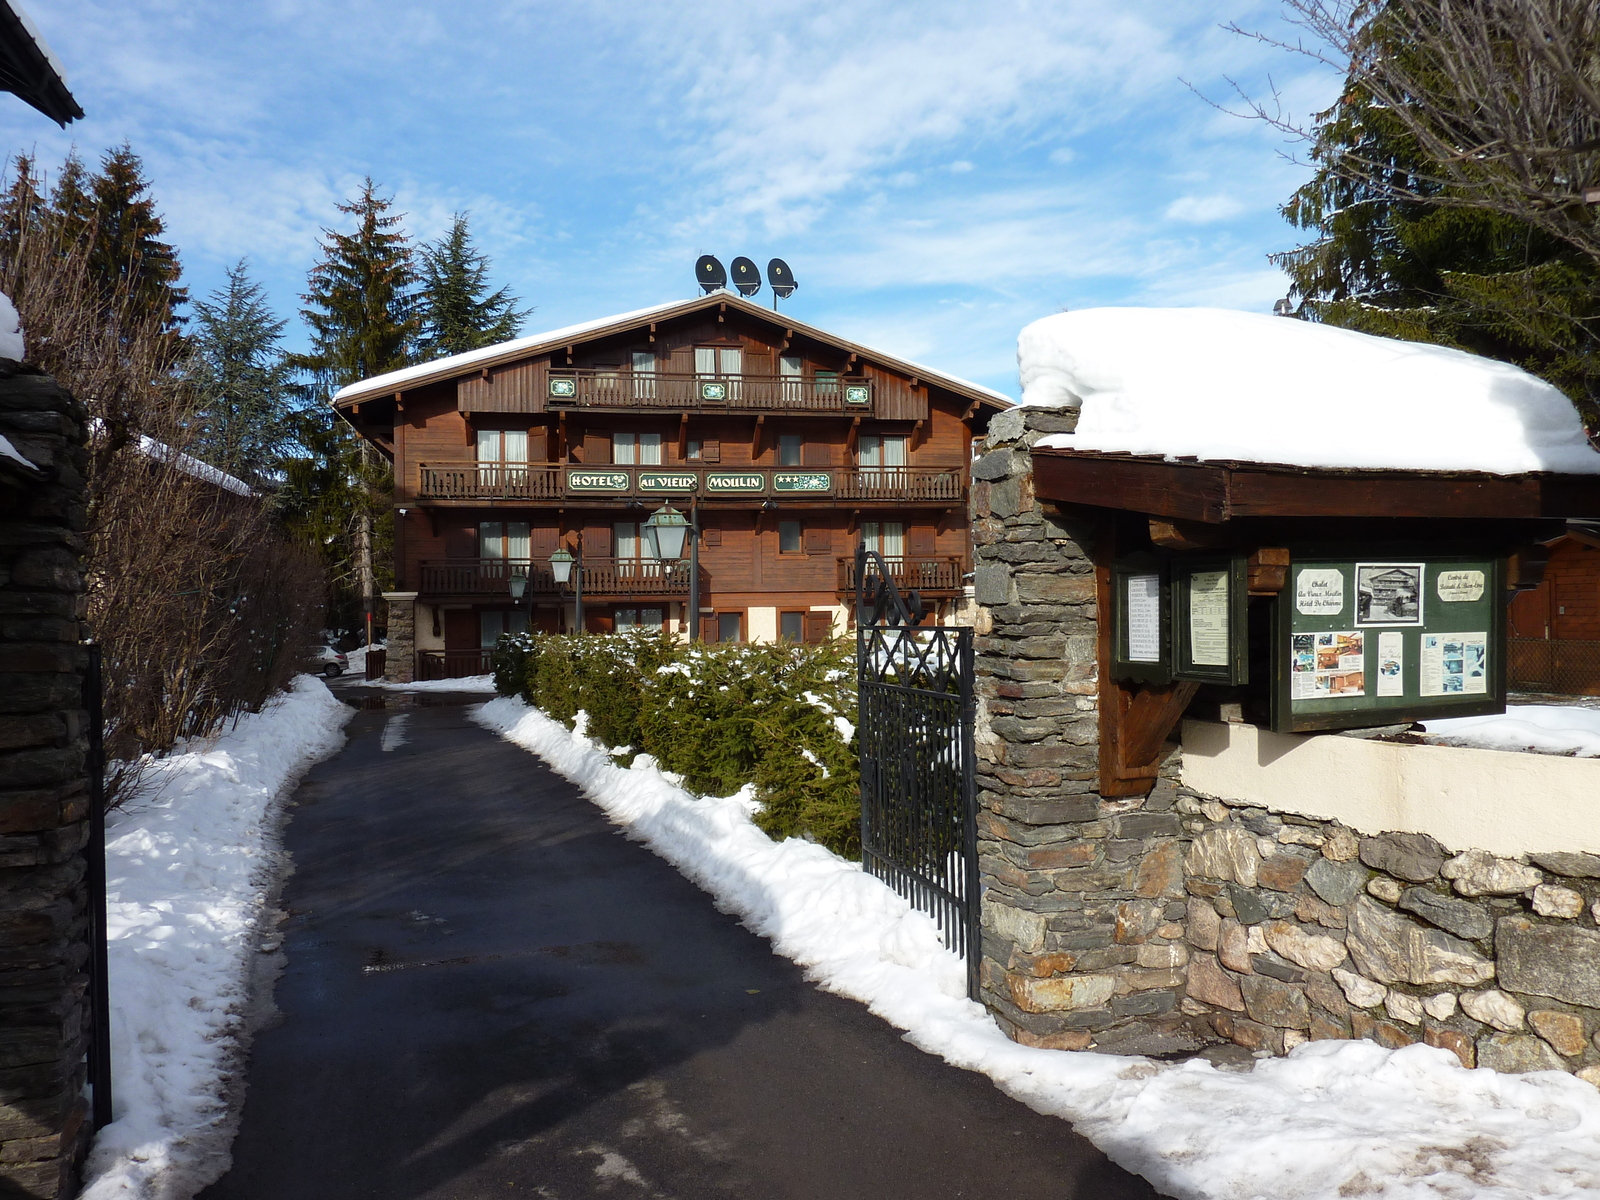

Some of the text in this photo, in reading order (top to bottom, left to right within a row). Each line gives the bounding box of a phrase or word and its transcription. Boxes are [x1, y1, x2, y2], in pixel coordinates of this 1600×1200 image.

[572, 475, 614, 487] HOTEL
[657, 477, 696, 488] VIEUX
[709, 476, 760, 488] MOULIN
